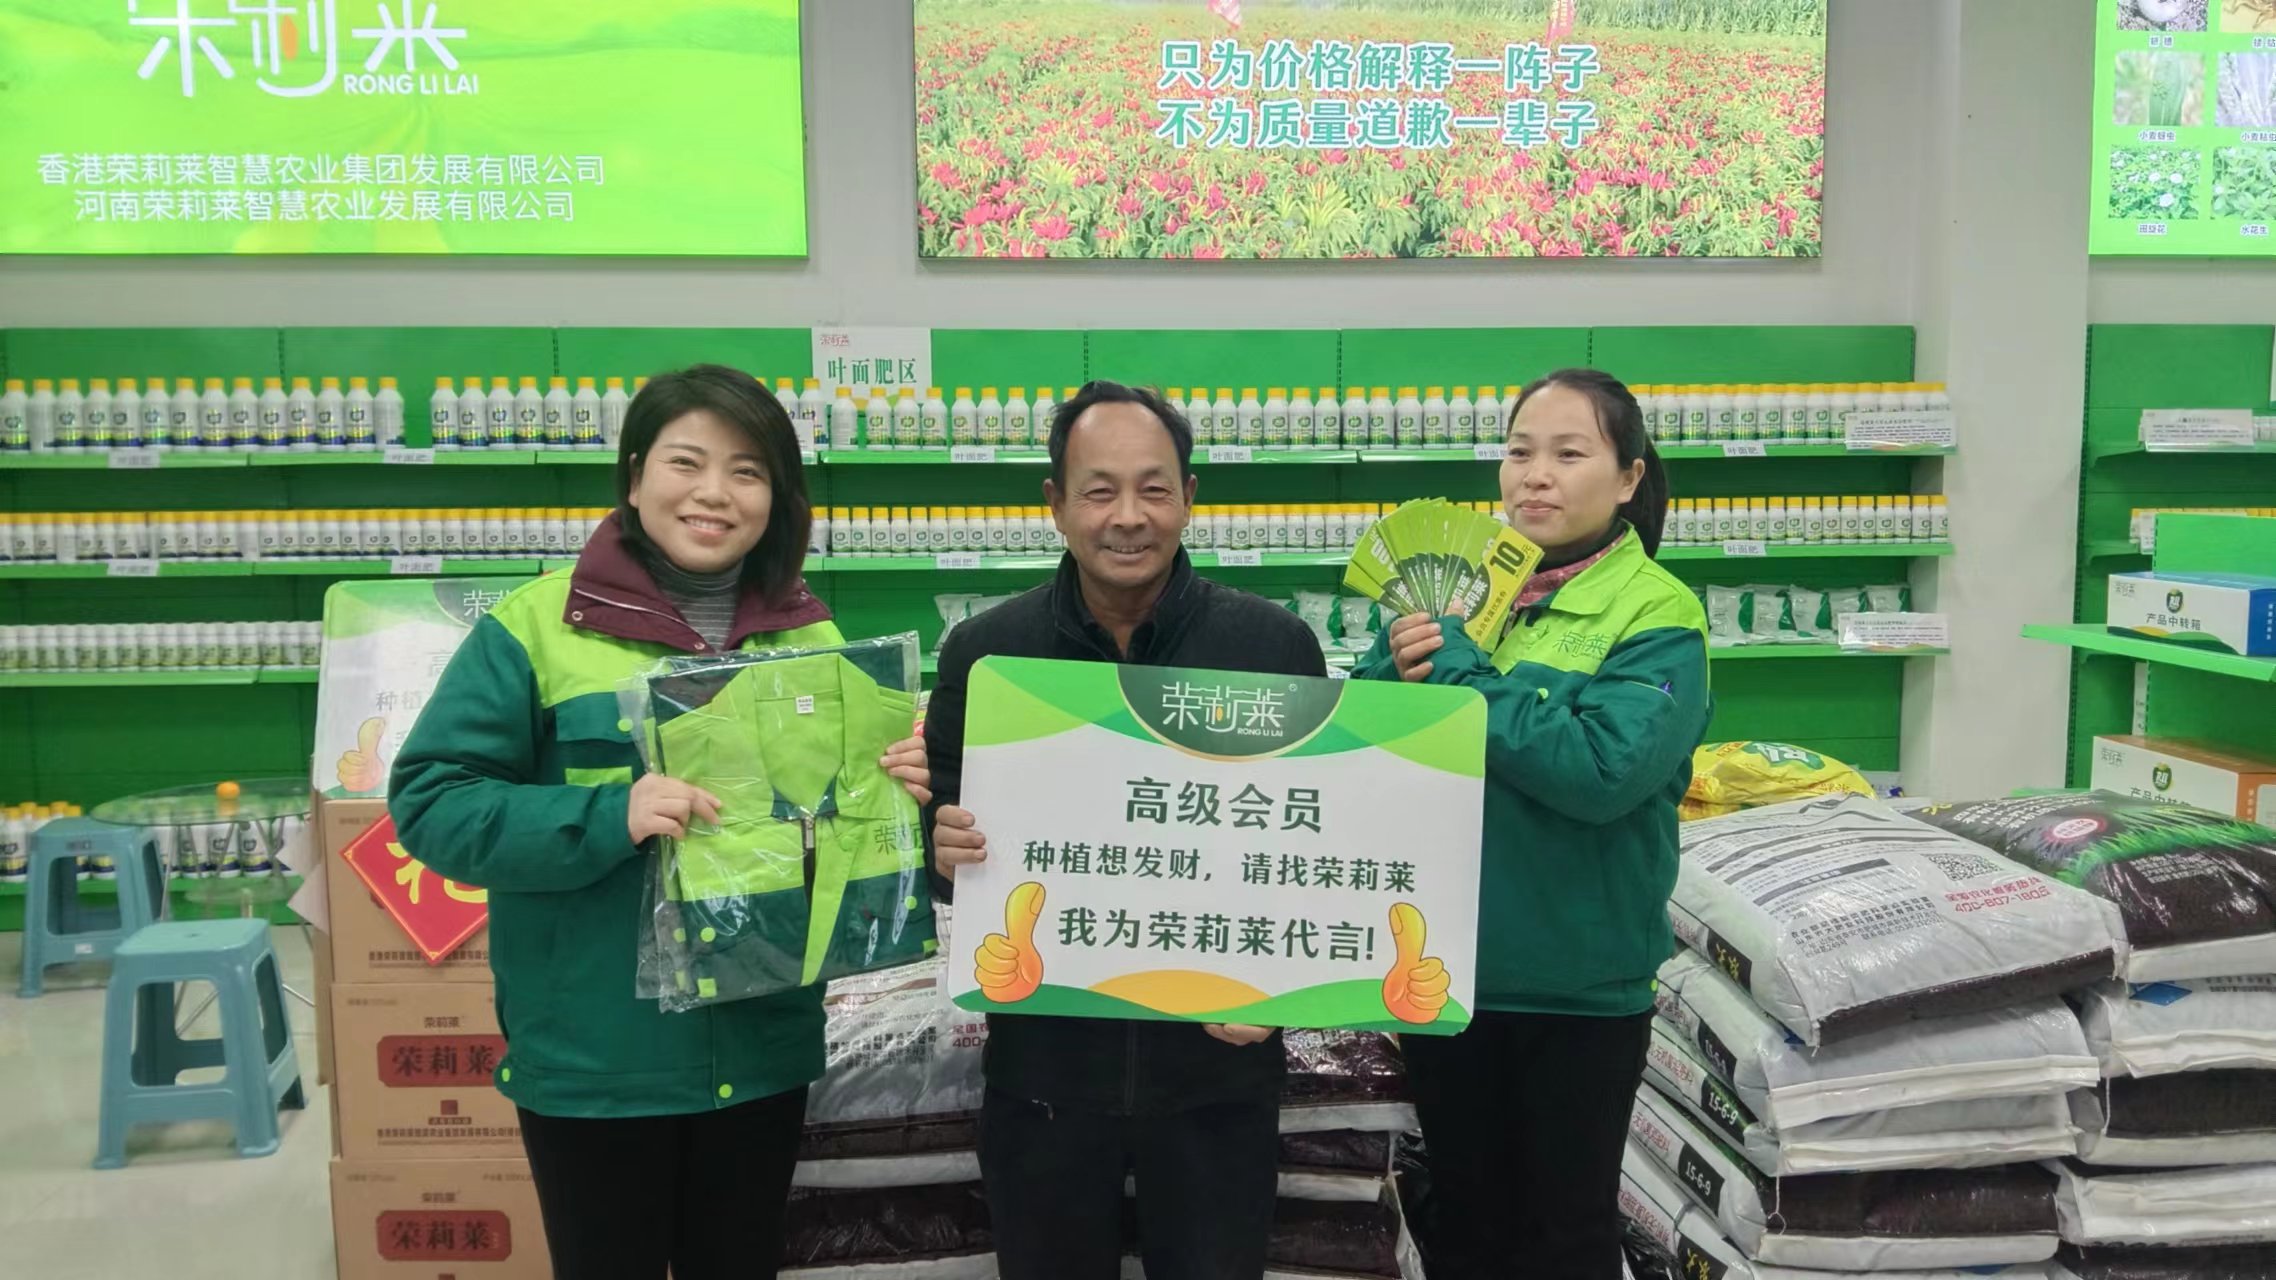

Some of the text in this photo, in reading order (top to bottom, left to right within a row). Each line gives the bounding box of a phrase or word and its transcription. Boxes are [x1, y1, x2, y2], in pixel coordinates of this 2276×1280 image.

[1158, 40, 1599, 90] 只为价格解释一阵子
[344, 74, 479, 95] RONG LI LAI
[1157, 100, 1598, 149] 不为质量道歉一辈子
[36, 153, 605, 187] 香港荣莉莱智慧农业集团发展有限公司
[74, 190, 576, 222] 河南荣莉莱智慧农业发展有限公司
[827, 357, 917, 385] 叶面肥区
[1490, 541, 1525, 576] 10
[2146, 613, 2201, 631] 产品中转箱
[1162, 681, 1285, 732] 荣莉莱
[1237, 727, 1262, 736] RONG
[1126, 777, 1322, 833] 高级会员
[1058, 907, 1375, 962] 我为荣莉莱代言!
[392, 1044, 495, 1077] 荣莉莱
[1708, 1091, 1739, 1126] 15-6-9
[1685, 1161, 1712, 1197] 15-6-9
[391, 1220, 489, 1250] 荣莉莱
